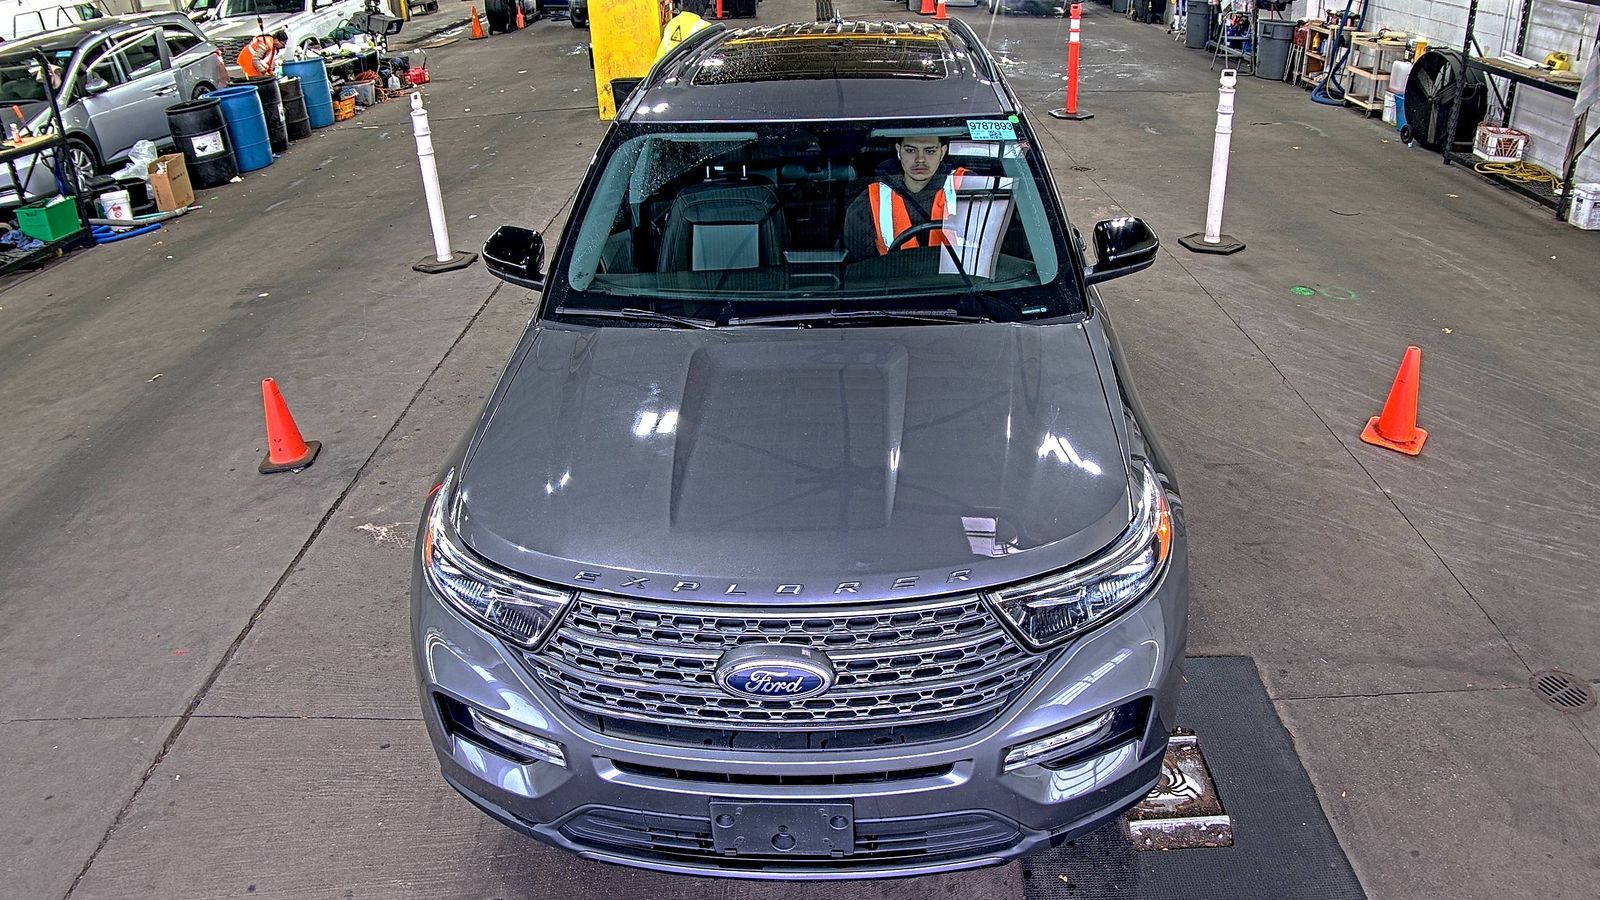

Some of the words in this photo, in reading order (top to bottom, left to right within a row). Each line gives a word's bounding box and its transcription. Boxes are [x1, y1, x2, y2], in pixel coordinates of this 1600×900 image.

[969, 121, 1013, 131] 9787893
[575, 569, 972, 596] EXPLORER
[745, 669, 804, 694] Ford
